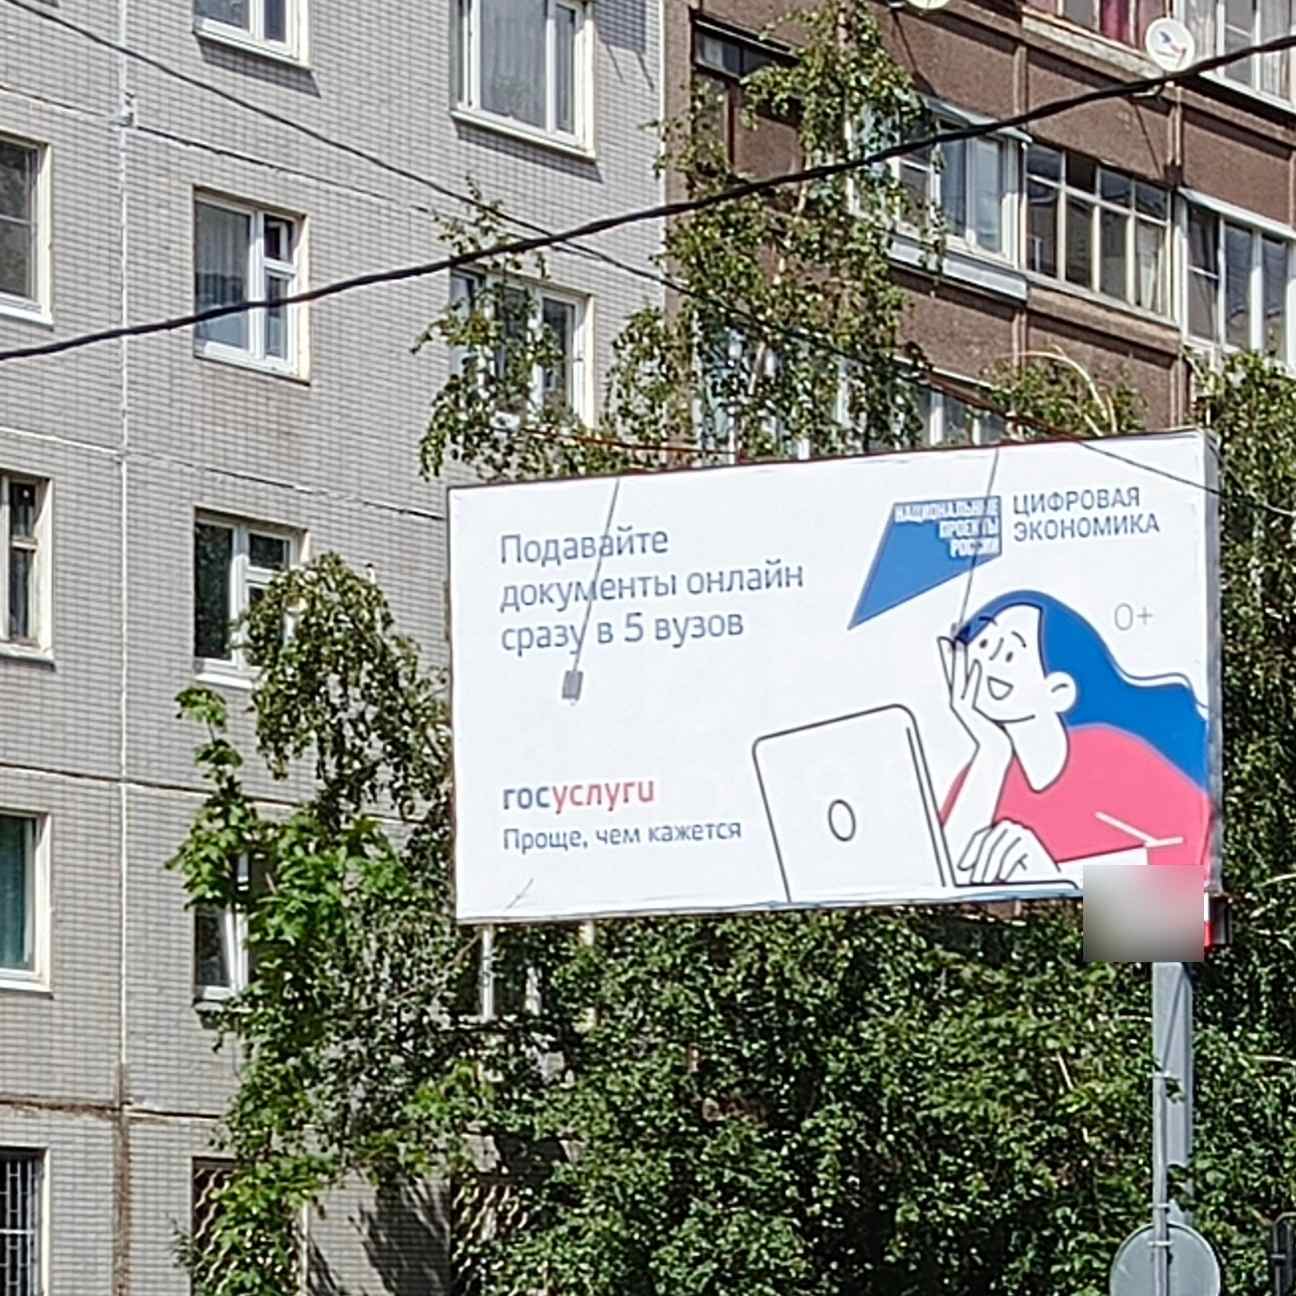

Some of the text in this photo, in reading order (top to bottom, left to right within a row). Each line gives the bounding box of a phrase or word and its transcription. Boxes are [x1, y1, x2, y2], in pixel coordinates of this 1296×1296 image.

[1012, 486, 1140, 515] ЦИФРОВАЯ
[1013, 513, 1160, 542] ЭКОНОМИКА
[500, 525, 669, 567] Подавайте
[500, 558, 804, 612] документы онлайн
[1113, 602, 1154, 631] 0+
[501, 611, 744, 657] сразу в 5 вузов
[503, 780, 655, 814] госуслуги
[503, 822, 742, 854] Проще, чем кажется
